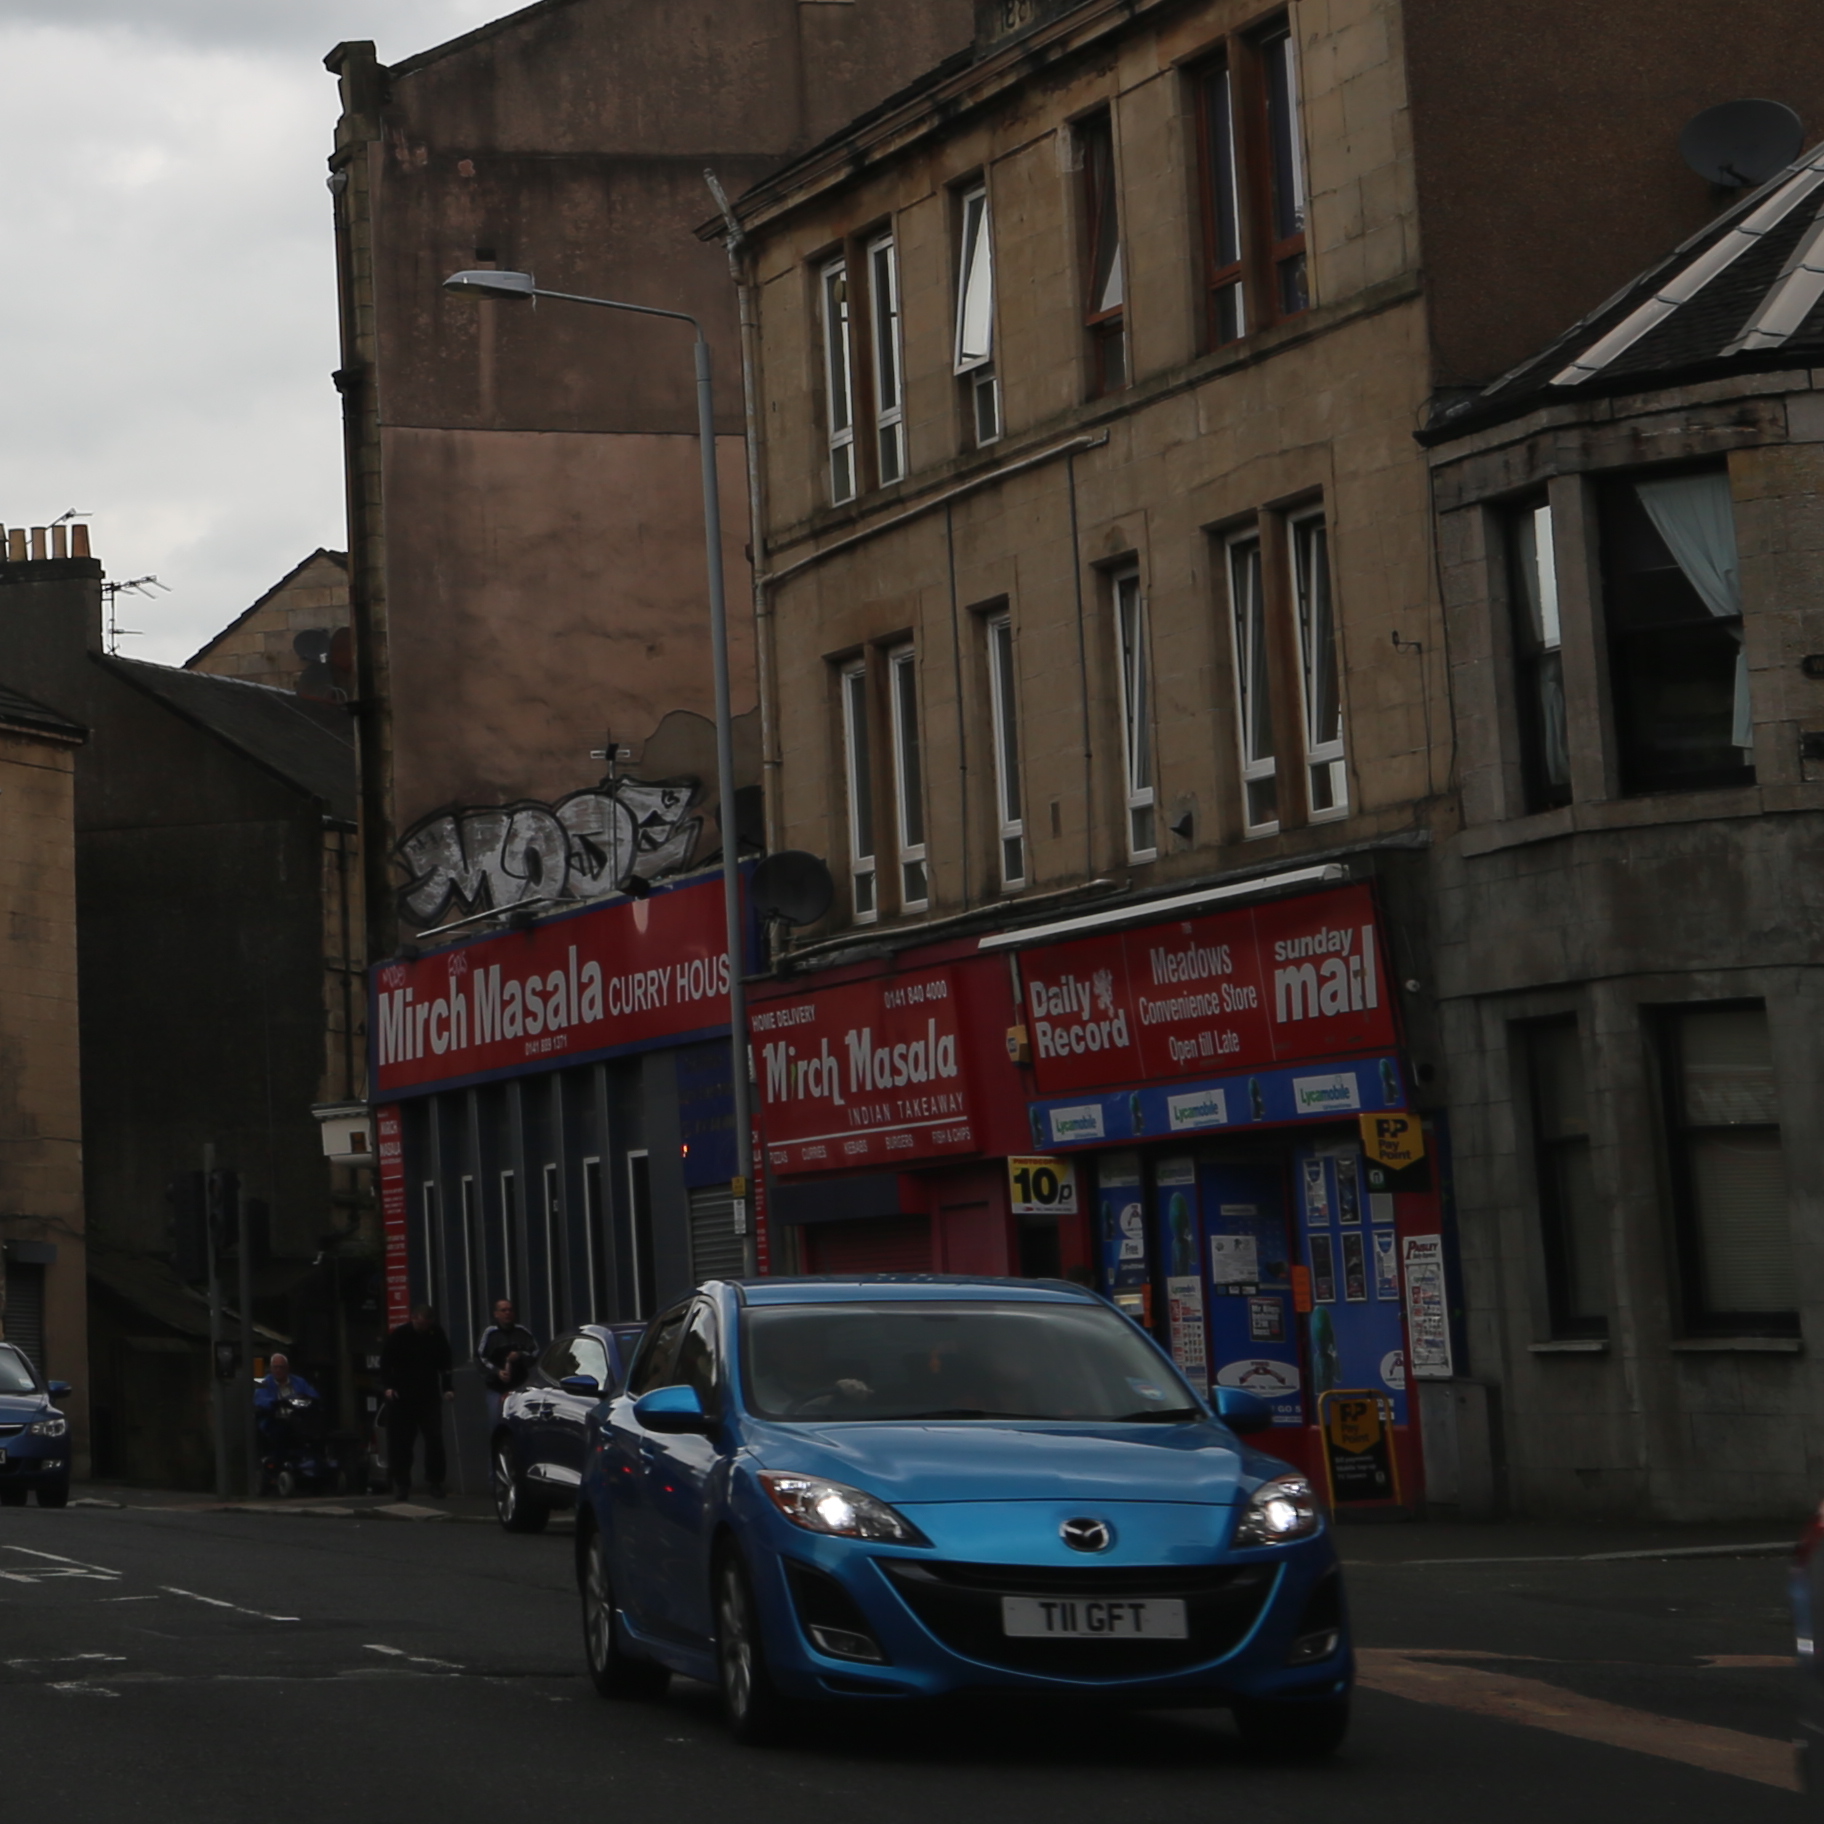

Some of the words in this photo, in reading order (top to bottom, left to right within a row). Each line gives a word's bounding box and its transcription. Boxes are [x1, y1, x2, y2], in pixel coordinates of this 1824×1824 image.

[1274, 927, 1353, 961] sunday
[1149, 941, 1233, 986] Meadows
[1274, 924, 1378, 1024] mail
[378, 975, 467, 1066] Mirch
[473, 945, 604, 1046] Masala
[608, 965, 671, 1016] CURRY
[676, 953, 729, 1003] HOUS
[884, 989, 907, 1008] 0141
[908, 985, 925, 1005] 840
[925, 980, 948, 1002] 4000
[1029, 975, 1091, 1021] Daily
[1138, 991, 1220, 1026] Convenience
[1220, 982, 1258, 1013] Store
[751, 1012, 776, 1032] HOME
[777, 1004, 815, 1028] DELIVERY
[1035, 1007, 1130, 1059] Record
[762, 1037, 845, 1106] Mirch
[844, 1018, 958, 1093] Masala
[1168, 1035, 1198, 1065] Open
[1199, 1032, 1215, 1057] till
[1217, 1029, 1240, 1055] Late
[848, 1103, 891, 1126] INDIAN
[897, 1092, 964, 1119] TAKEAWAY
[1174, 1101, 1218, 1122] Lycamobile
[1301, 1084, 1350, 1105] Lycamobile
[1055, 1115, 1096, 1135] Lycamobile
[1379, 1139, 1400, 1151] Pay
[1379, 1149, 1412, 1160] Point
[1014, 1167, 1072, 1205] 10p
[1341, 1424, 1358, 1434] Pay
[1342, 1433, 1371, 1444] Point
[1086, 1602, 1146, 1632] GFT
